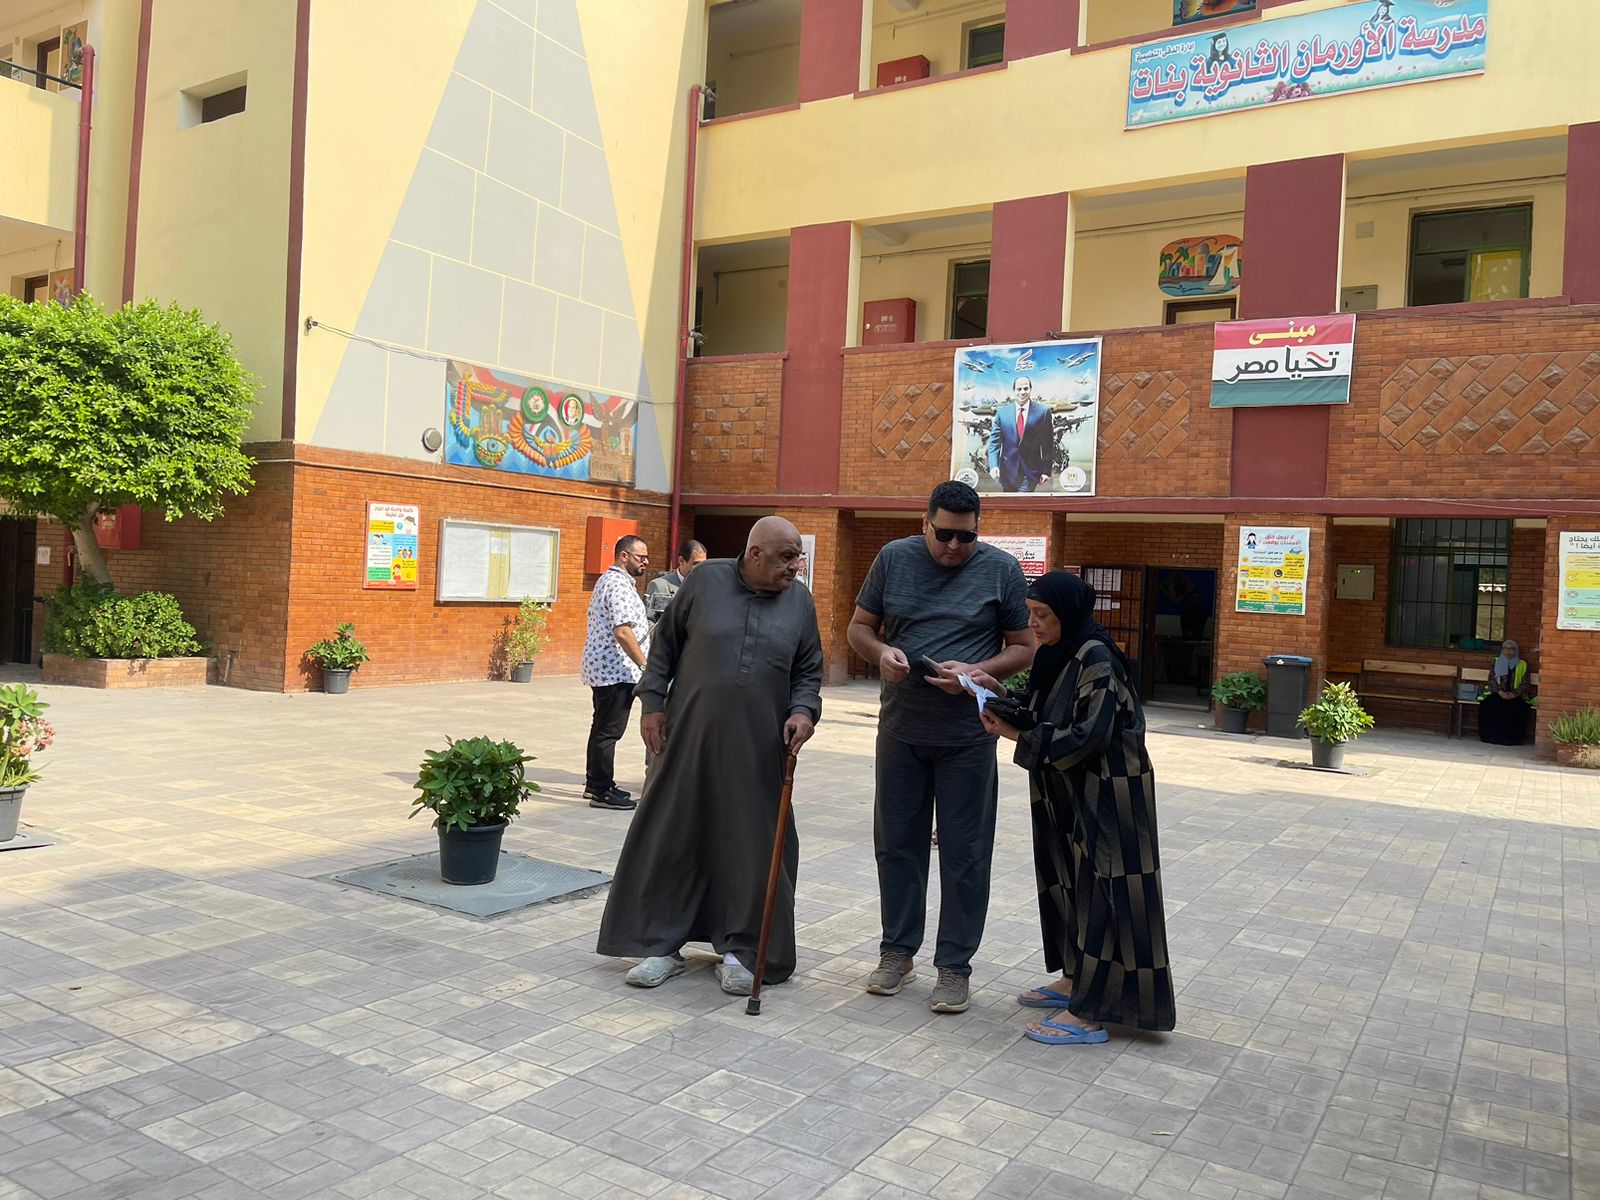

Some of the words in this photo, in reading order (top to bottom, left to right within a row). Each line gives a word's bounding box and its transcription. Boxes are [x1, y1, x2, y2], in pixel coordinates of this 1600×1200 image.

[1291, 21, 1395, 78] الأورمان
[1400, 14, 1487, 54] مدرسة
[1132, 64, 1188, 101] بنات
[1192, 38, 1290, 97] الثانوية
[1249, 321, 1316, 345] مبنى
[1224, 359, 1279, 382] مصر
[1285, 346, 1340, 378] تحيا
